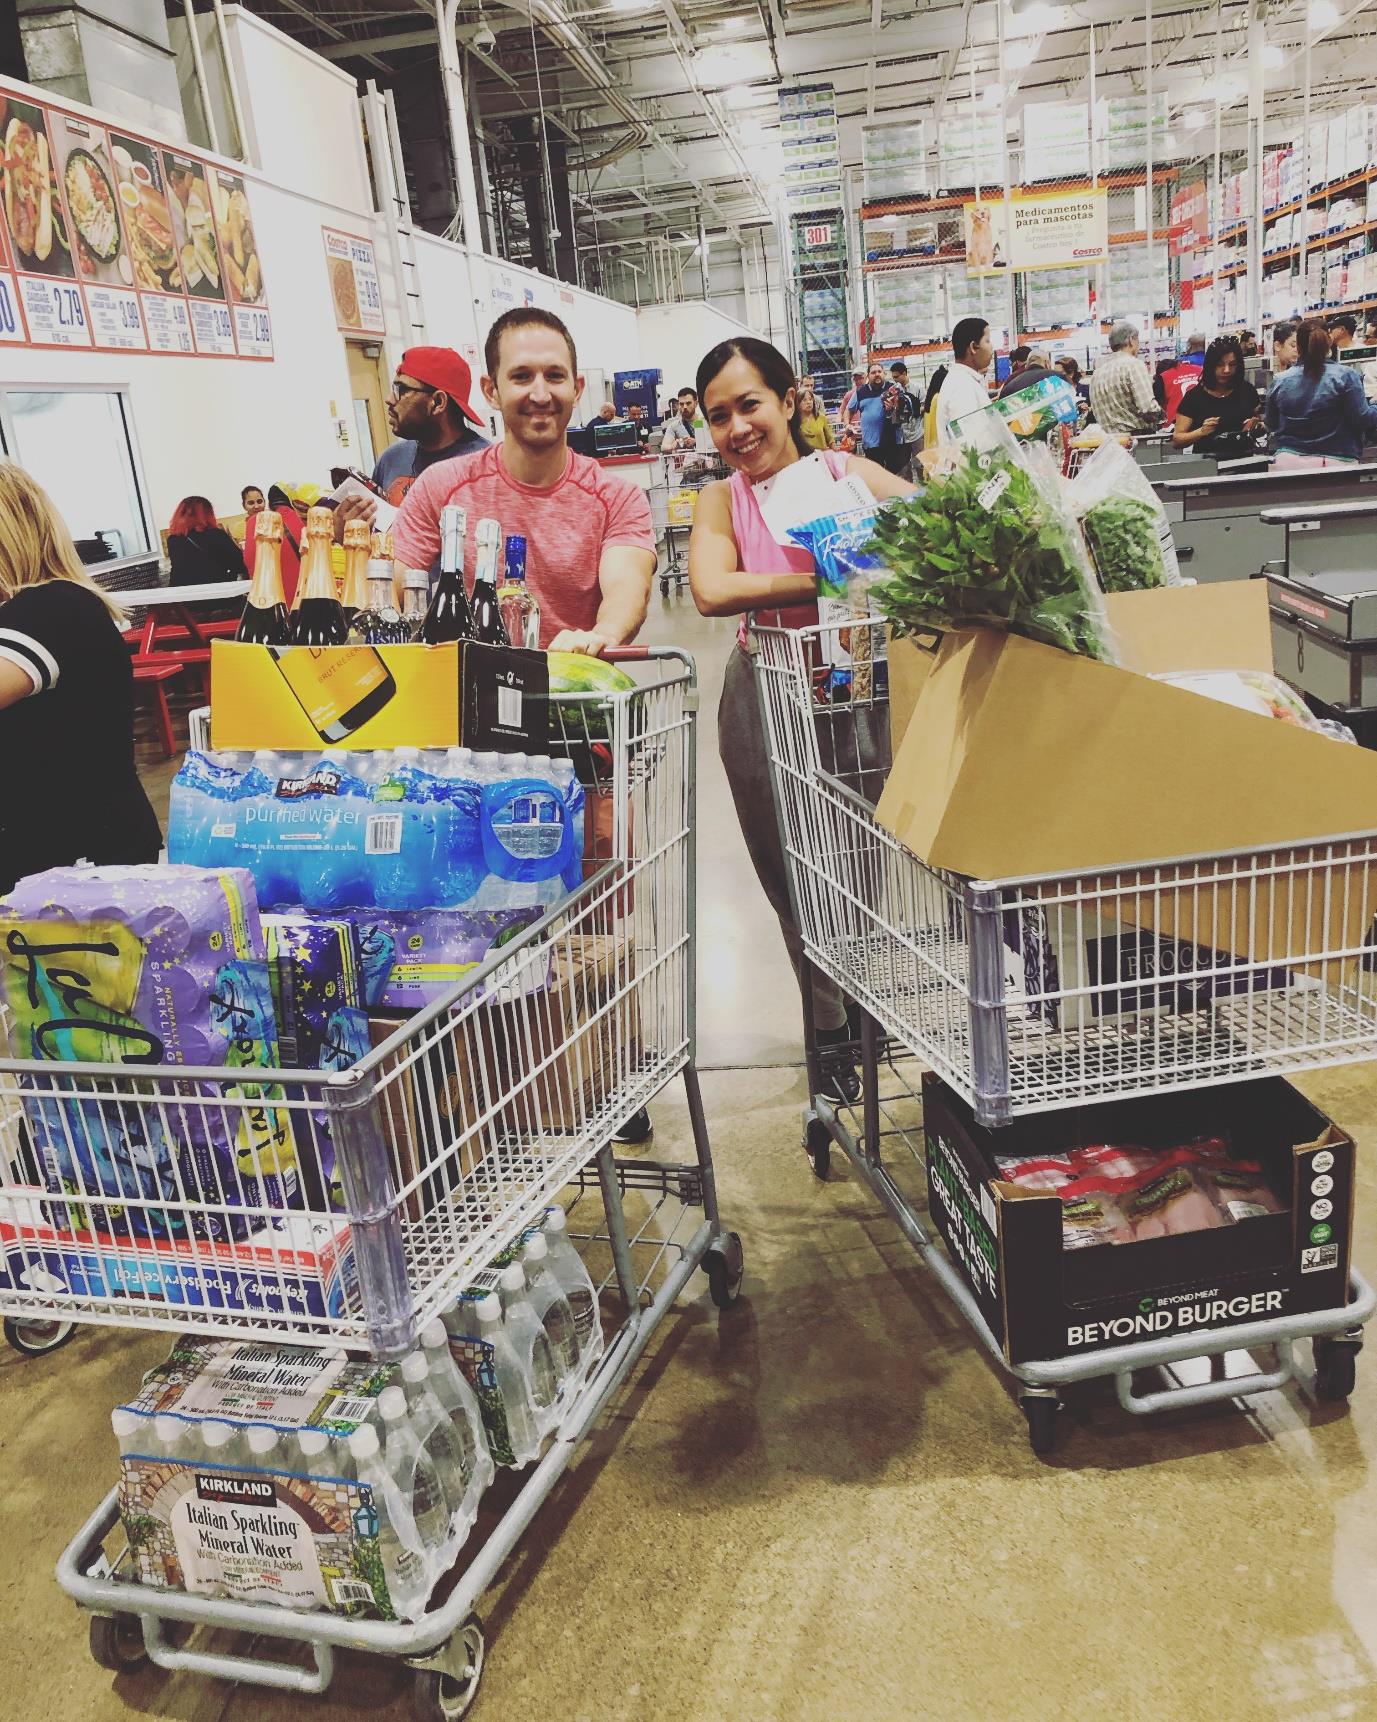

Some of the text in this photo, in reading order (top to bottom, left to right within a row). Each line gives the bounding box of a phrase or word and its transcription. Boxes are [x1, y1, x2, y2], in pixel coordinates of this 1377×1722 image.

[1015, 203, 1094, 219] Medicamentos
[1016, 212, 1094, 229] para mascotas
[807, 226, 828, 244] 301
[0, 280, 15, 333] 0
[53, 287, 84, 326] 2.79
[119, 300, 140, 328] 3.99
[309, 808, 362, 825] water
[1127, 945, 1227, 977] BROCC
[151, 961, 176, 1062] SPARKLING
[164, 987, 181, 1046] NATURALLY
[1316, 1202, 1328, 1210] NO
[930, 1165, 963, 1234] GREAT
[963, 1220, 997, 1300] TASTE
[114, 1268, 140, 1284] Fol
[141, 1271, 232, 1295] Foodservce
[1157, 1288, 1219, 1307] BEYOND MEAT
[1067, 1290, 1283, 1346] BEYOND BURGER
[231, 1346, 331, 1371] Italian Sparkling
[223, 1363, 311, 1387] Mineral Water
[211, 1379, 307, 1397] With Carbonation Added
[199, 1477, 273, 1497] KIRKLAND
[186, 1502, 298, 1540] Italian Sparkling
[198, 1528, 293, 1559] Mineral Water
[218, 1552, 272, 1569] Carbonation
[273, 1559, 304, 1572] Added
